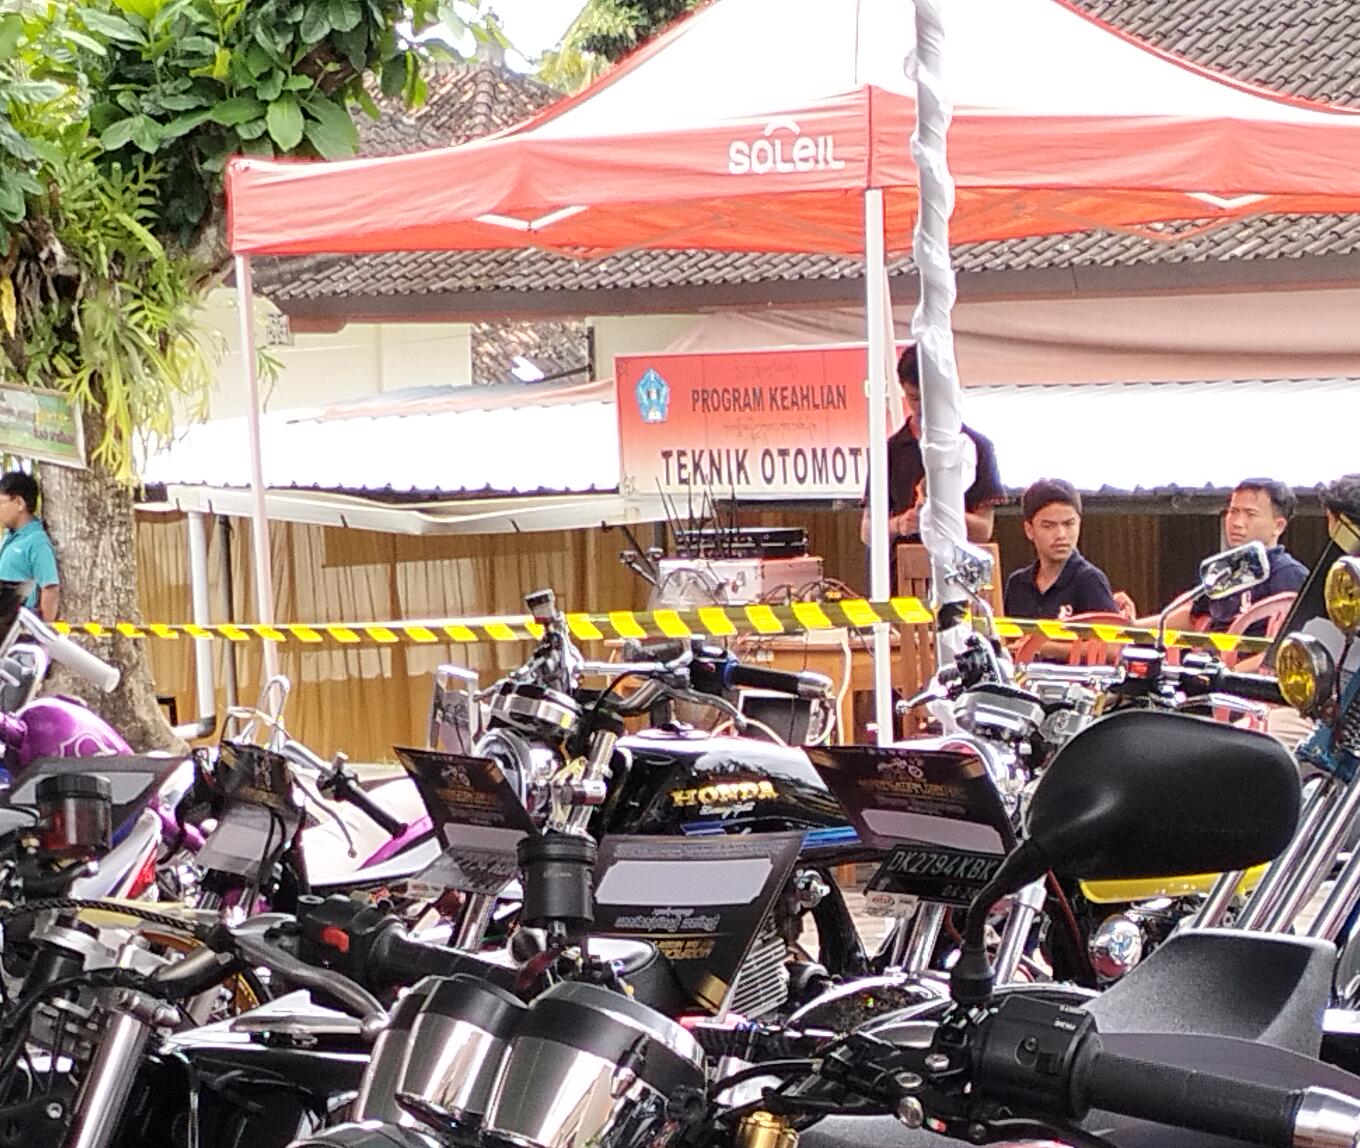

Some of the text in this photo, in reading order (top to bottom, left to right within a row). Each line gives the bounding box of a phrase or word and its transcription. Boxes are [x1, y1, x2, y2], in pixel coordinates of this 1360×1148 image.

[690, 384, 848, 412] PROGRAM KEAHLIAN
[661, 446, 870, 485] TEKNIK OTOMOT
[670, 780, 780, 807] HONDA
